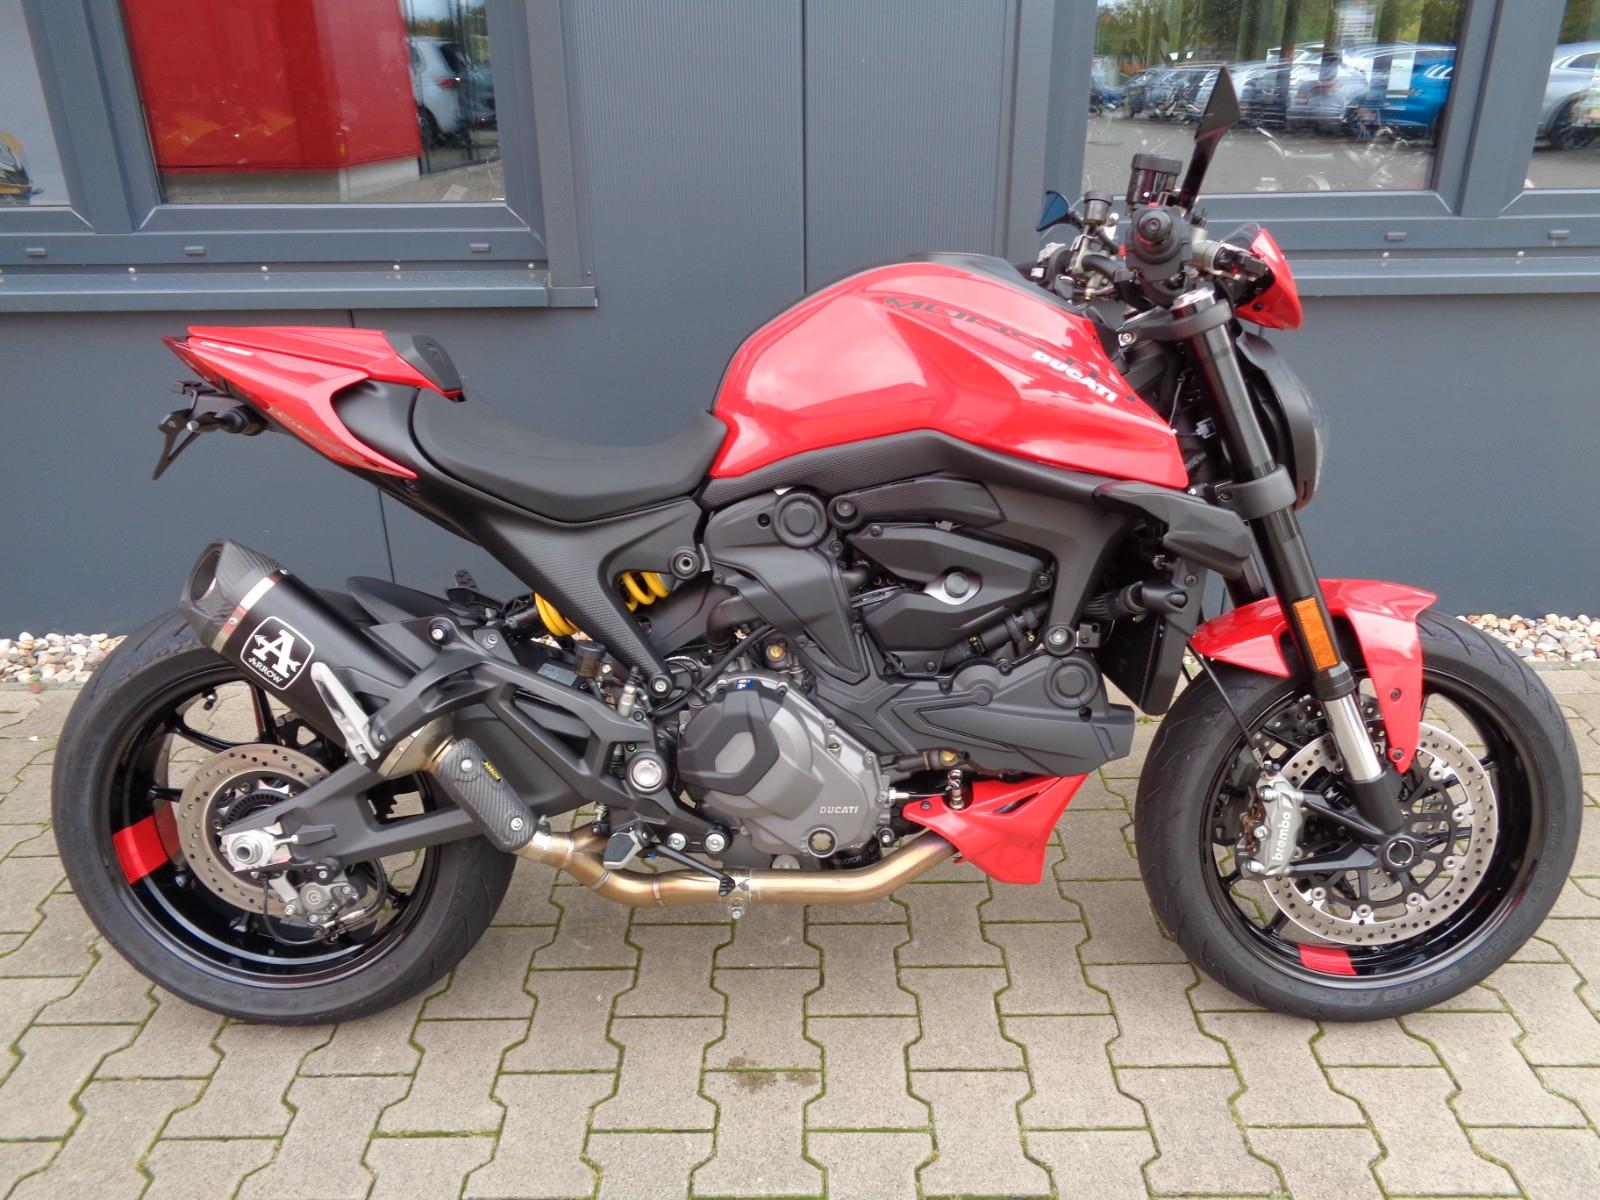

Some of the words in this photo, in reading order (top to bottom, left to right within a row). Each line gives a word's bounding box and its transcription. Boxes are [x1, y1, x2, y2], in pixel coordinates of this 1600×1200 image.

[1032, 350, 1117, 403] DUCATI
[248, 657, 283, 683] ARROW
[819, 806, 859, 814] DUCATI
[1271, 811, 1292, 861] brembo
